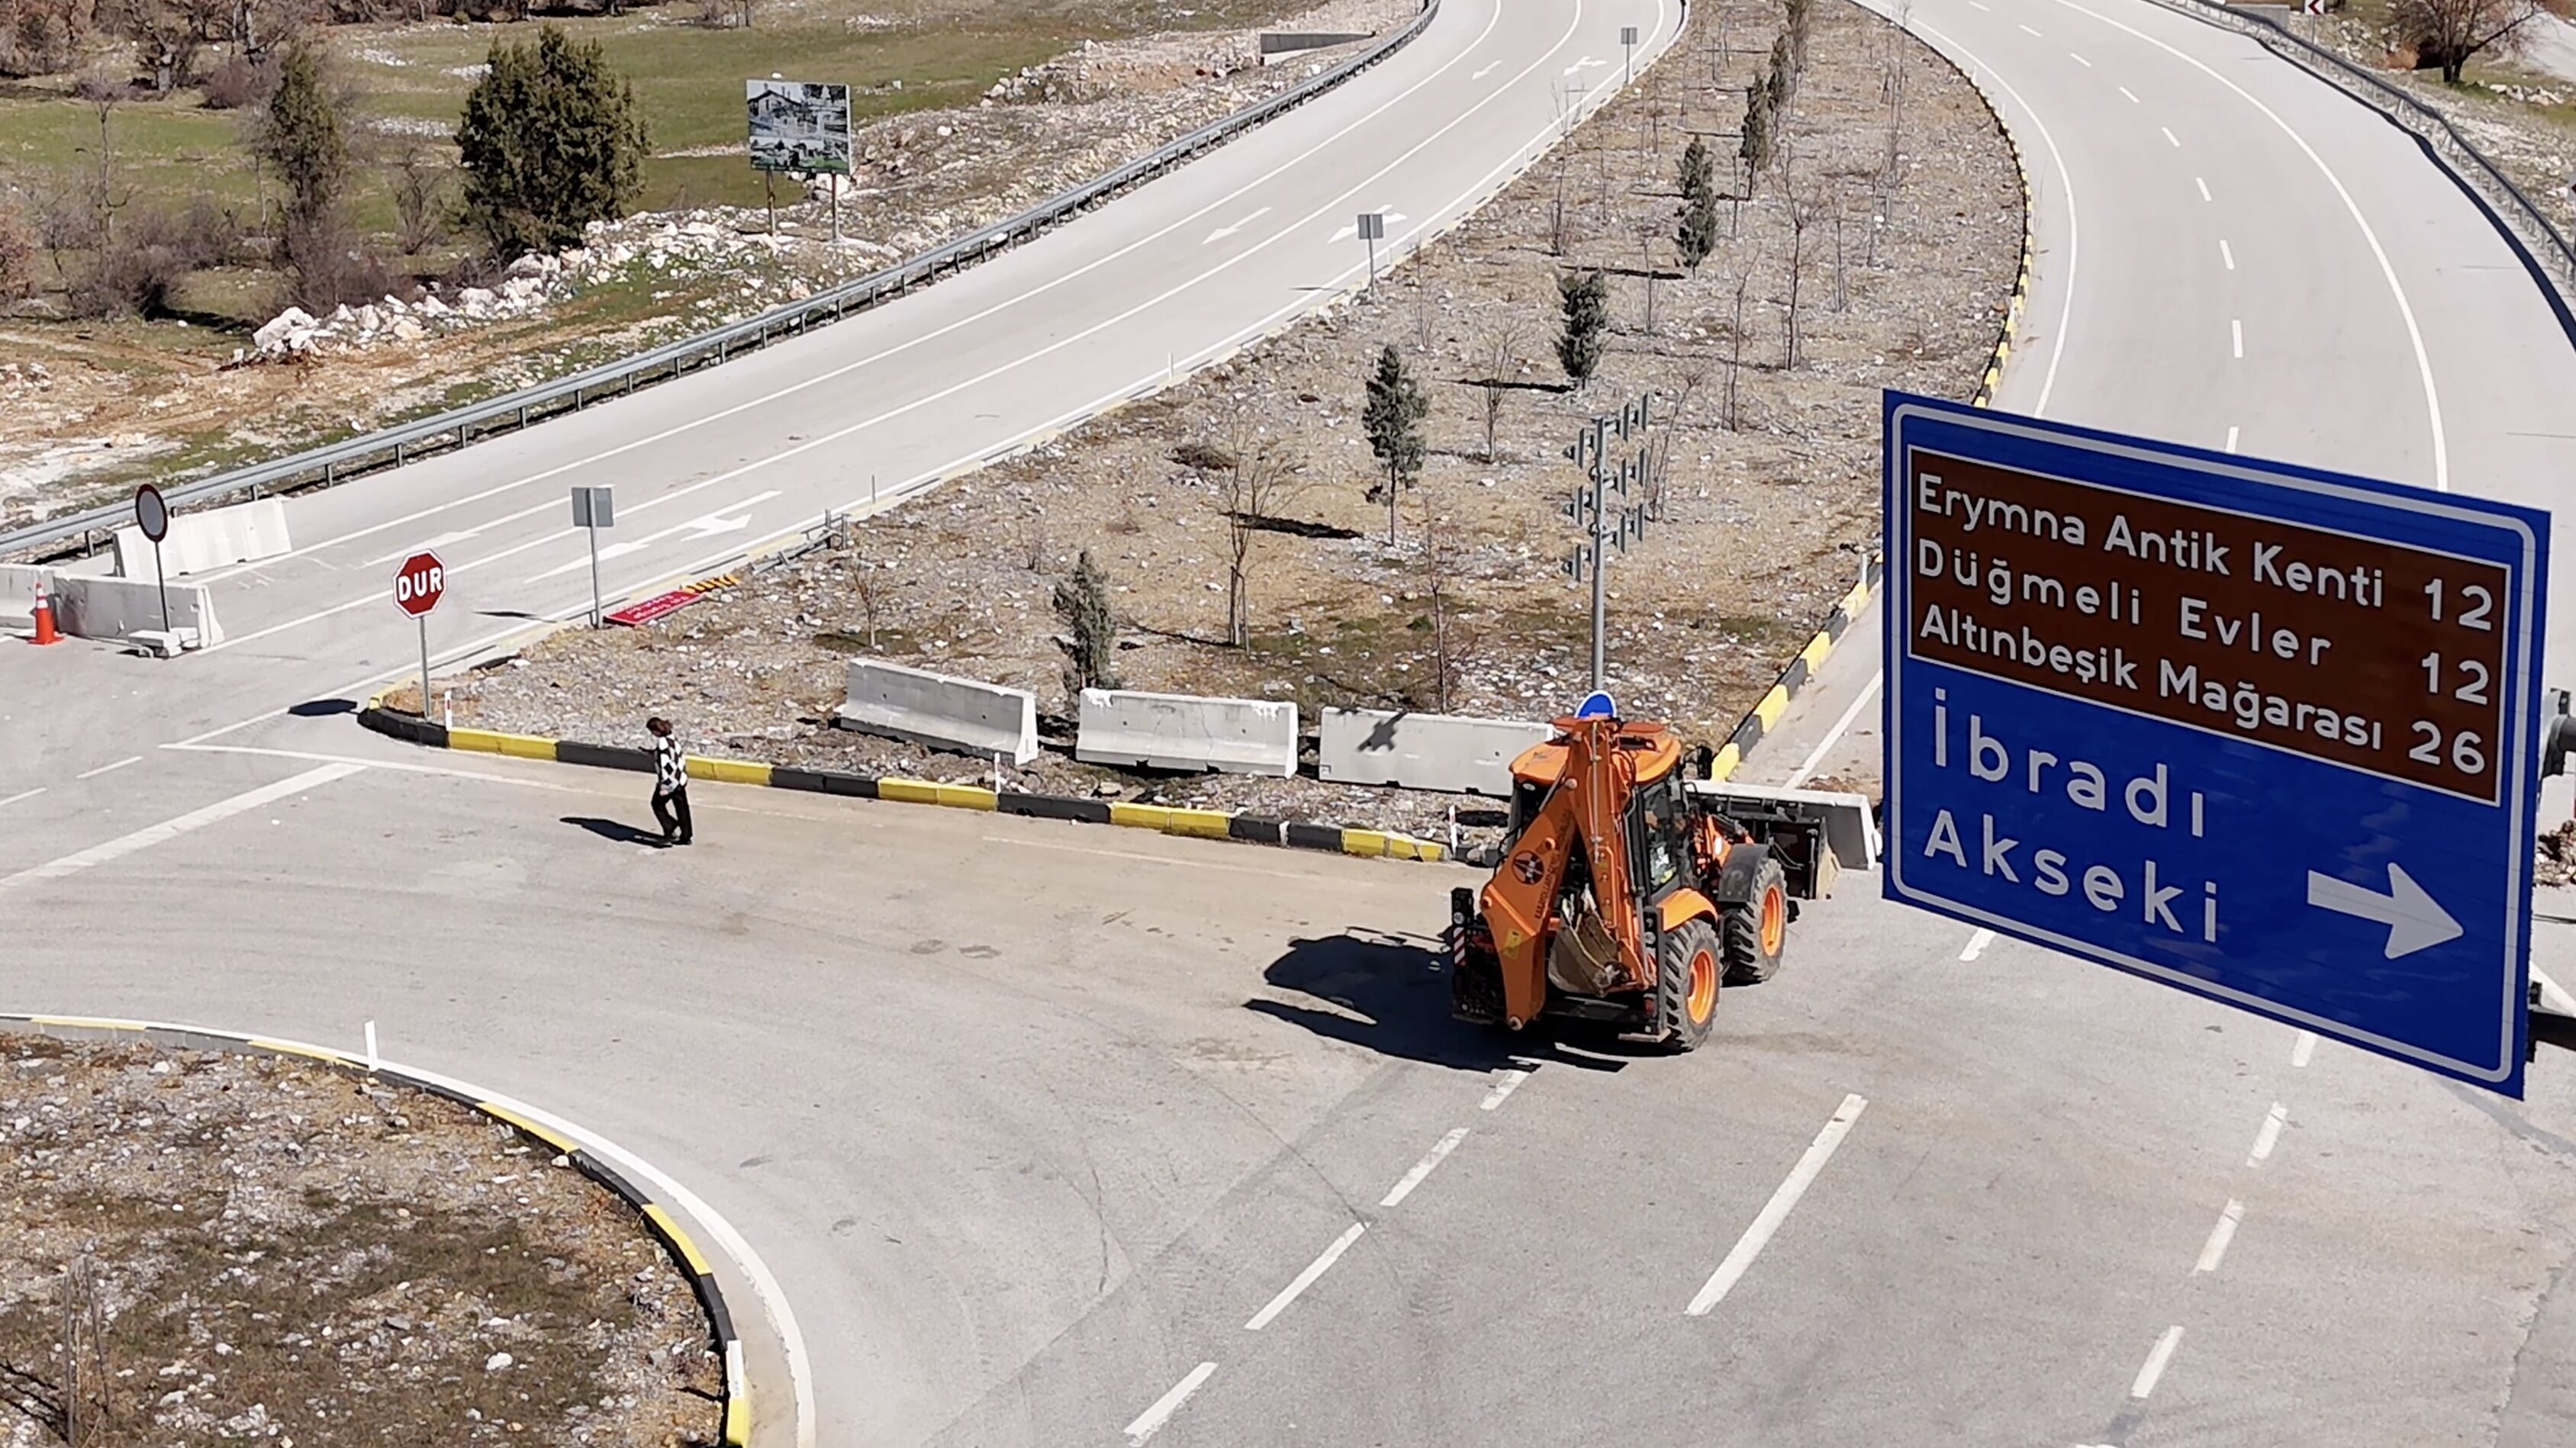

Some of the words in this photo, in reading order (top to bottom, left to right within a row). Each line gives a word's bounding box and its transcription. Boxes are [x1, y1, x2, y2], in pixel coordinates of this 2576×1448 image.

[398, 567, 443, 602] DUR
[1918, 537, 2141, 626] Düğmeli
[2181, 597, 2332, 666] Evler
[2421, 651, 2490, 706] 12
[1919, 471, 2085, 546] Erymna
[2104, 514, 2230, 576] Antik
[2253, 541, 2384, 609] Kenti
[2423, 578, 2493, 632] 12
[1919, 603, 2139, 690] Altınbeşik
[2159, 658, 2382, 751] Mağarası
[2408, 719, 2486, 775] 26
[1934, 686, 2204, 838] İbradı
[1923, 808, 2218, 944] Akseki
